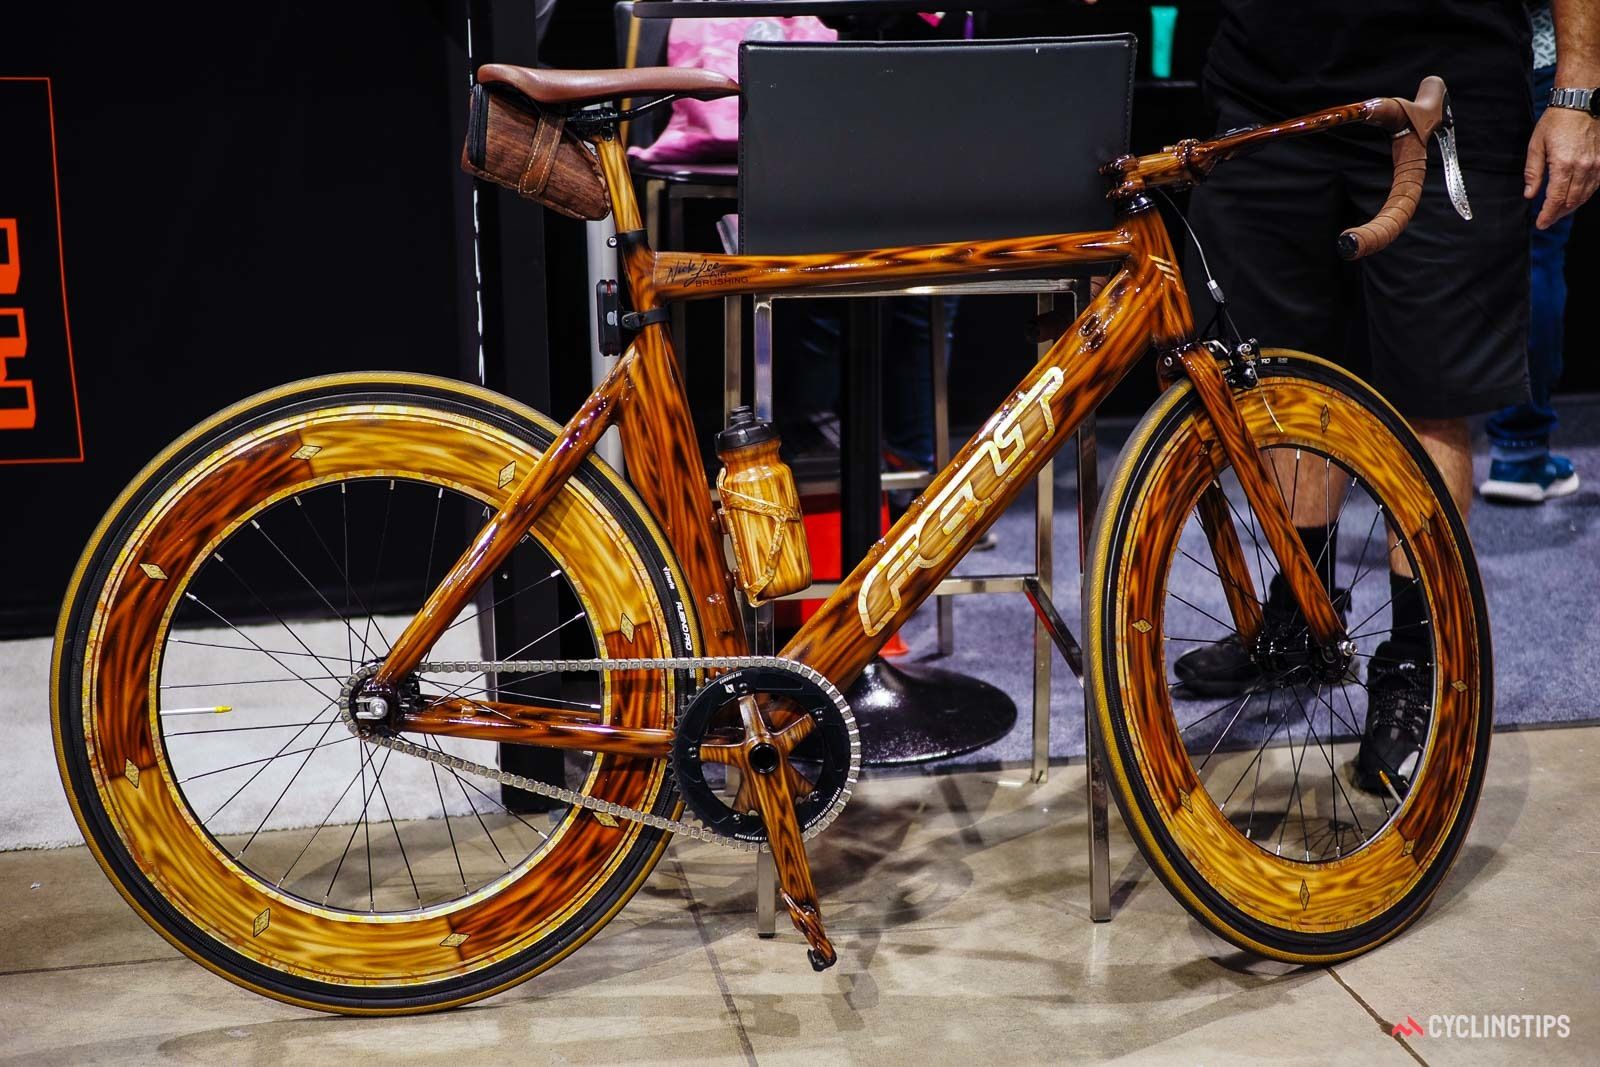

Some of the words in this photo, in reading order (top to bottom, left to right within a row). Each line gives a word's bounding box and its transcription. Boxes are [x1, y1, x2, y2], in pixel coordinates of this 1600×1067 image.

[695, 276, 748, 287] BRUSHING
[675, 601, 689, 633] RUBINO
[683, 632, 693, 651] PRO
